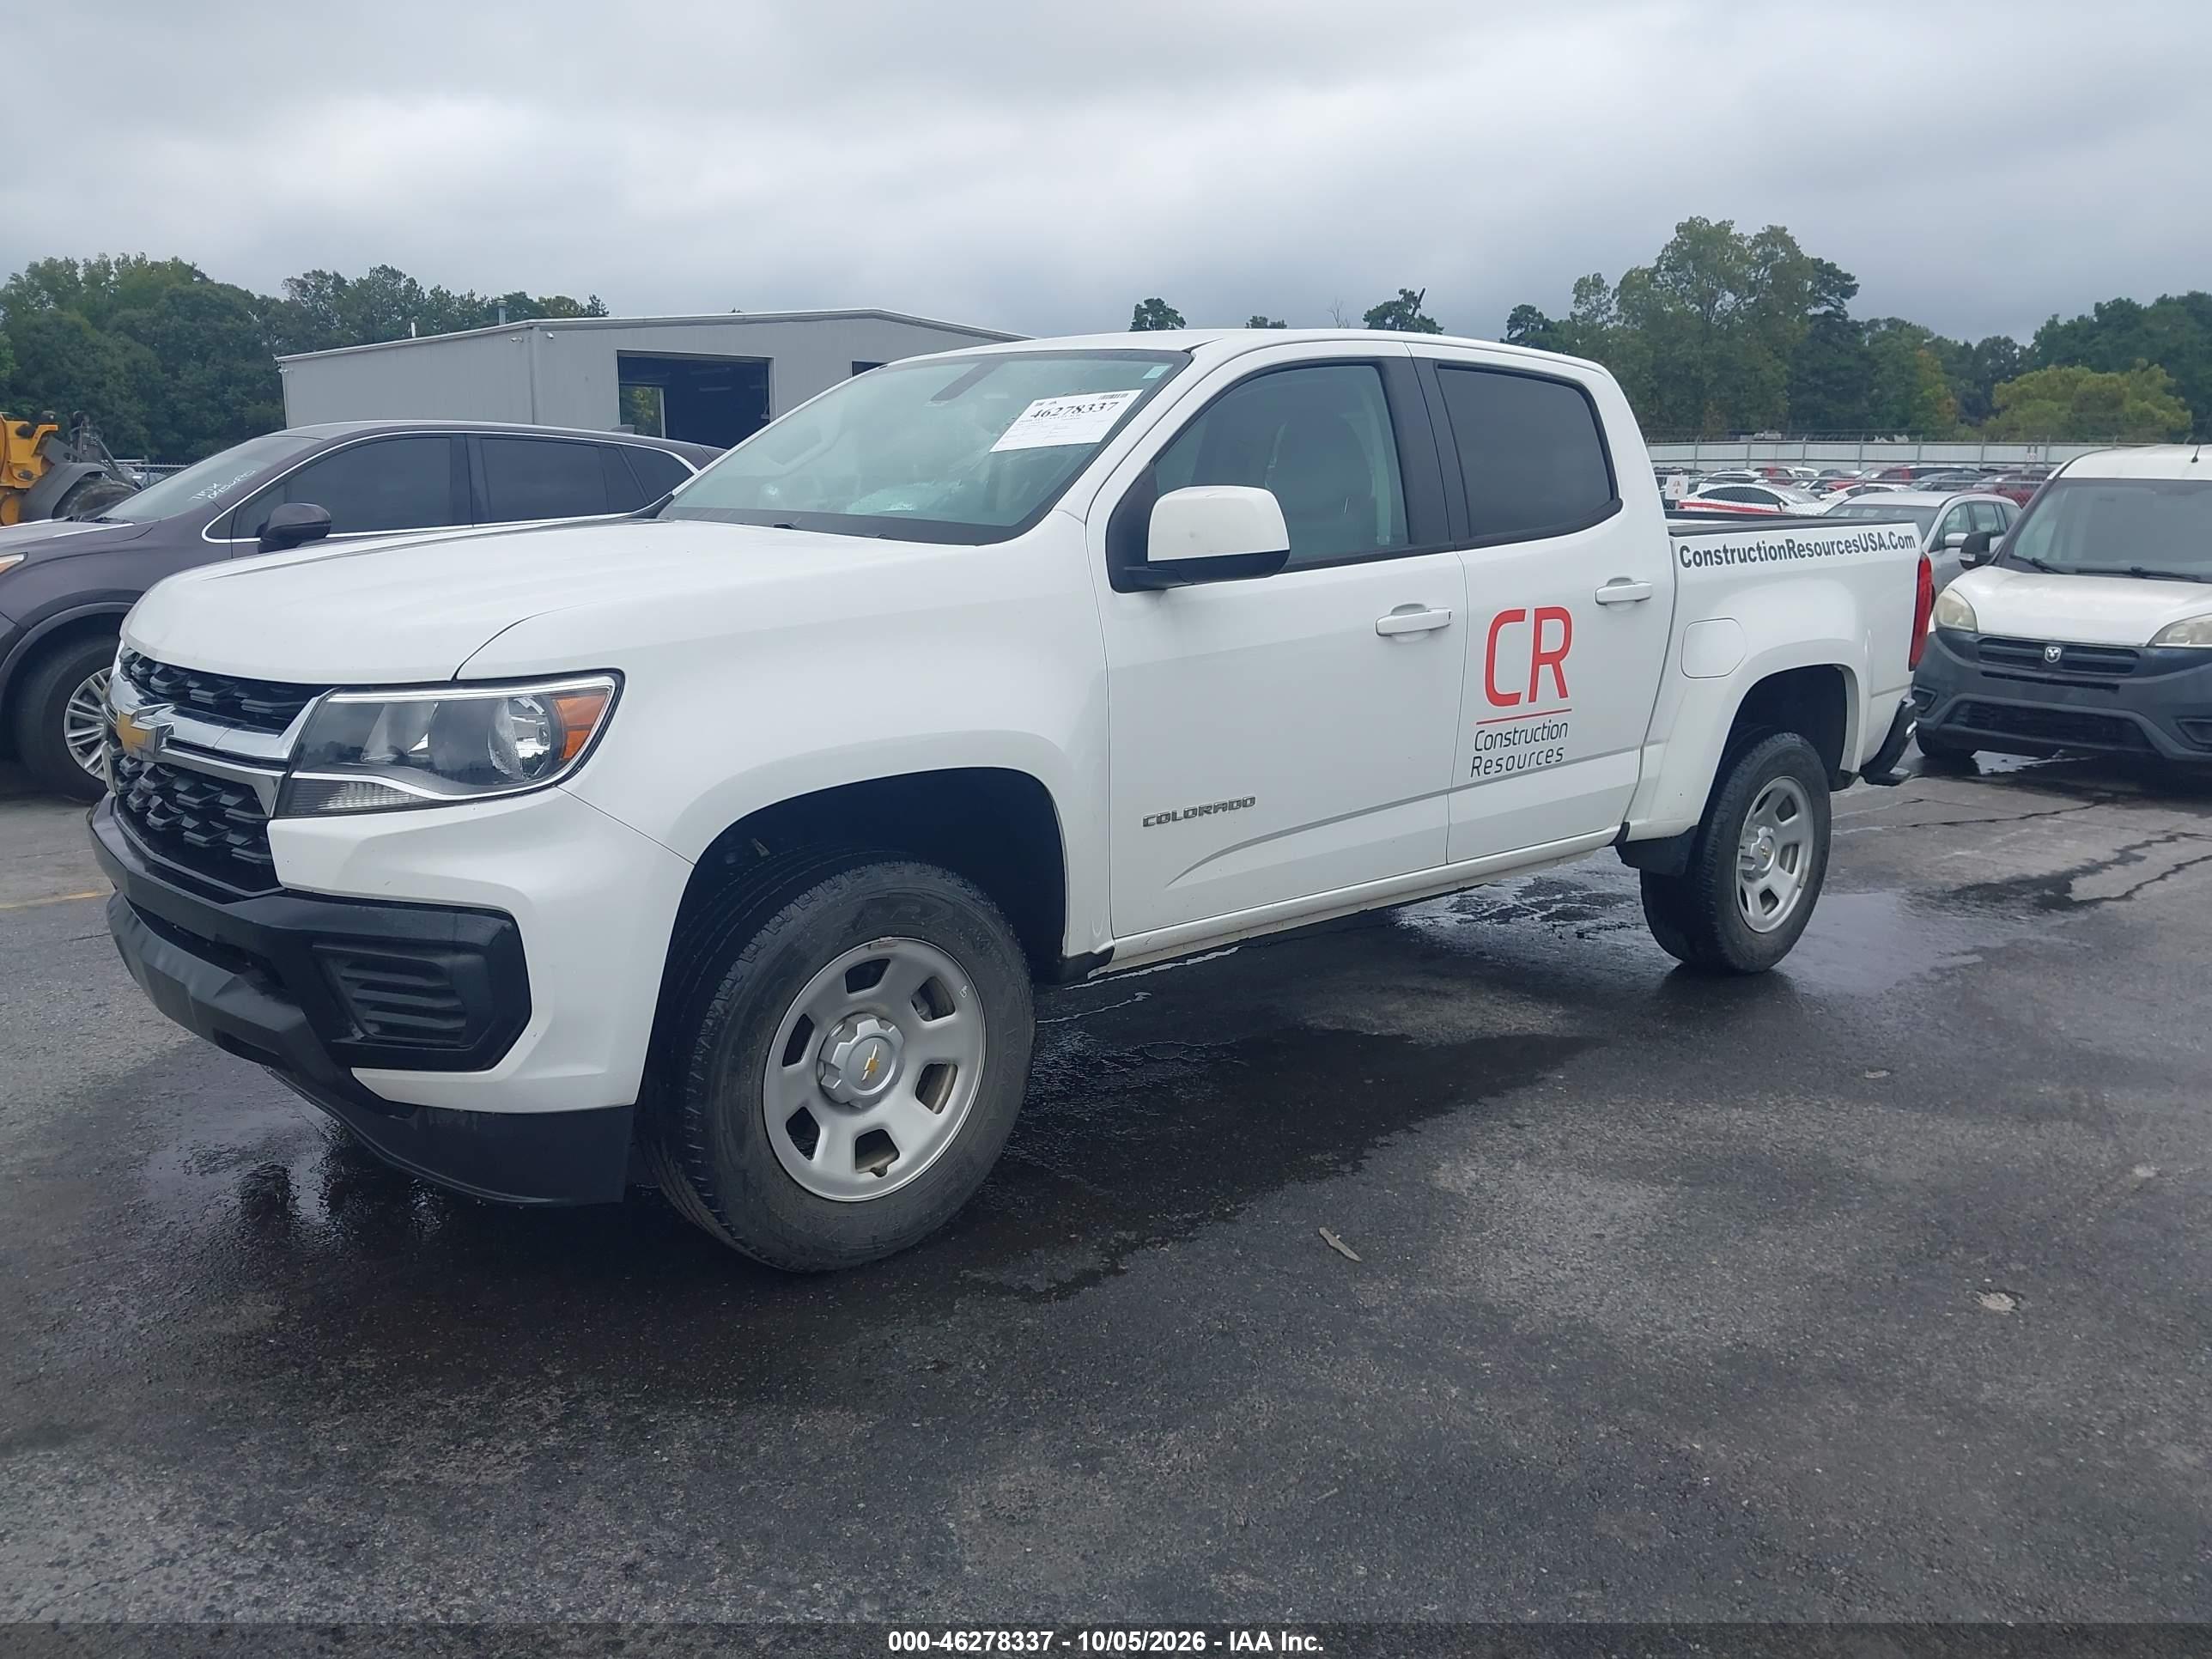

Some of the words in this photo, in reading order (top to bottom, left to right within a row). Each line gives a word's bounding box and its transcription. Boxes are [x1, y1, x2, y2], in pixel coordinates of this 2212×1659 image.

[1030, 402, 1120, 418] 46278337
[1679, 531, 1916, 568] ConstructionResourcesUSA.Com
[1485, 606, 1572, 708] CR
[1474, 719, 1569, 752] Construction
[1470, 746, 1565, 778] Resources
[1142, 795, 1256, 828] COLORADO
